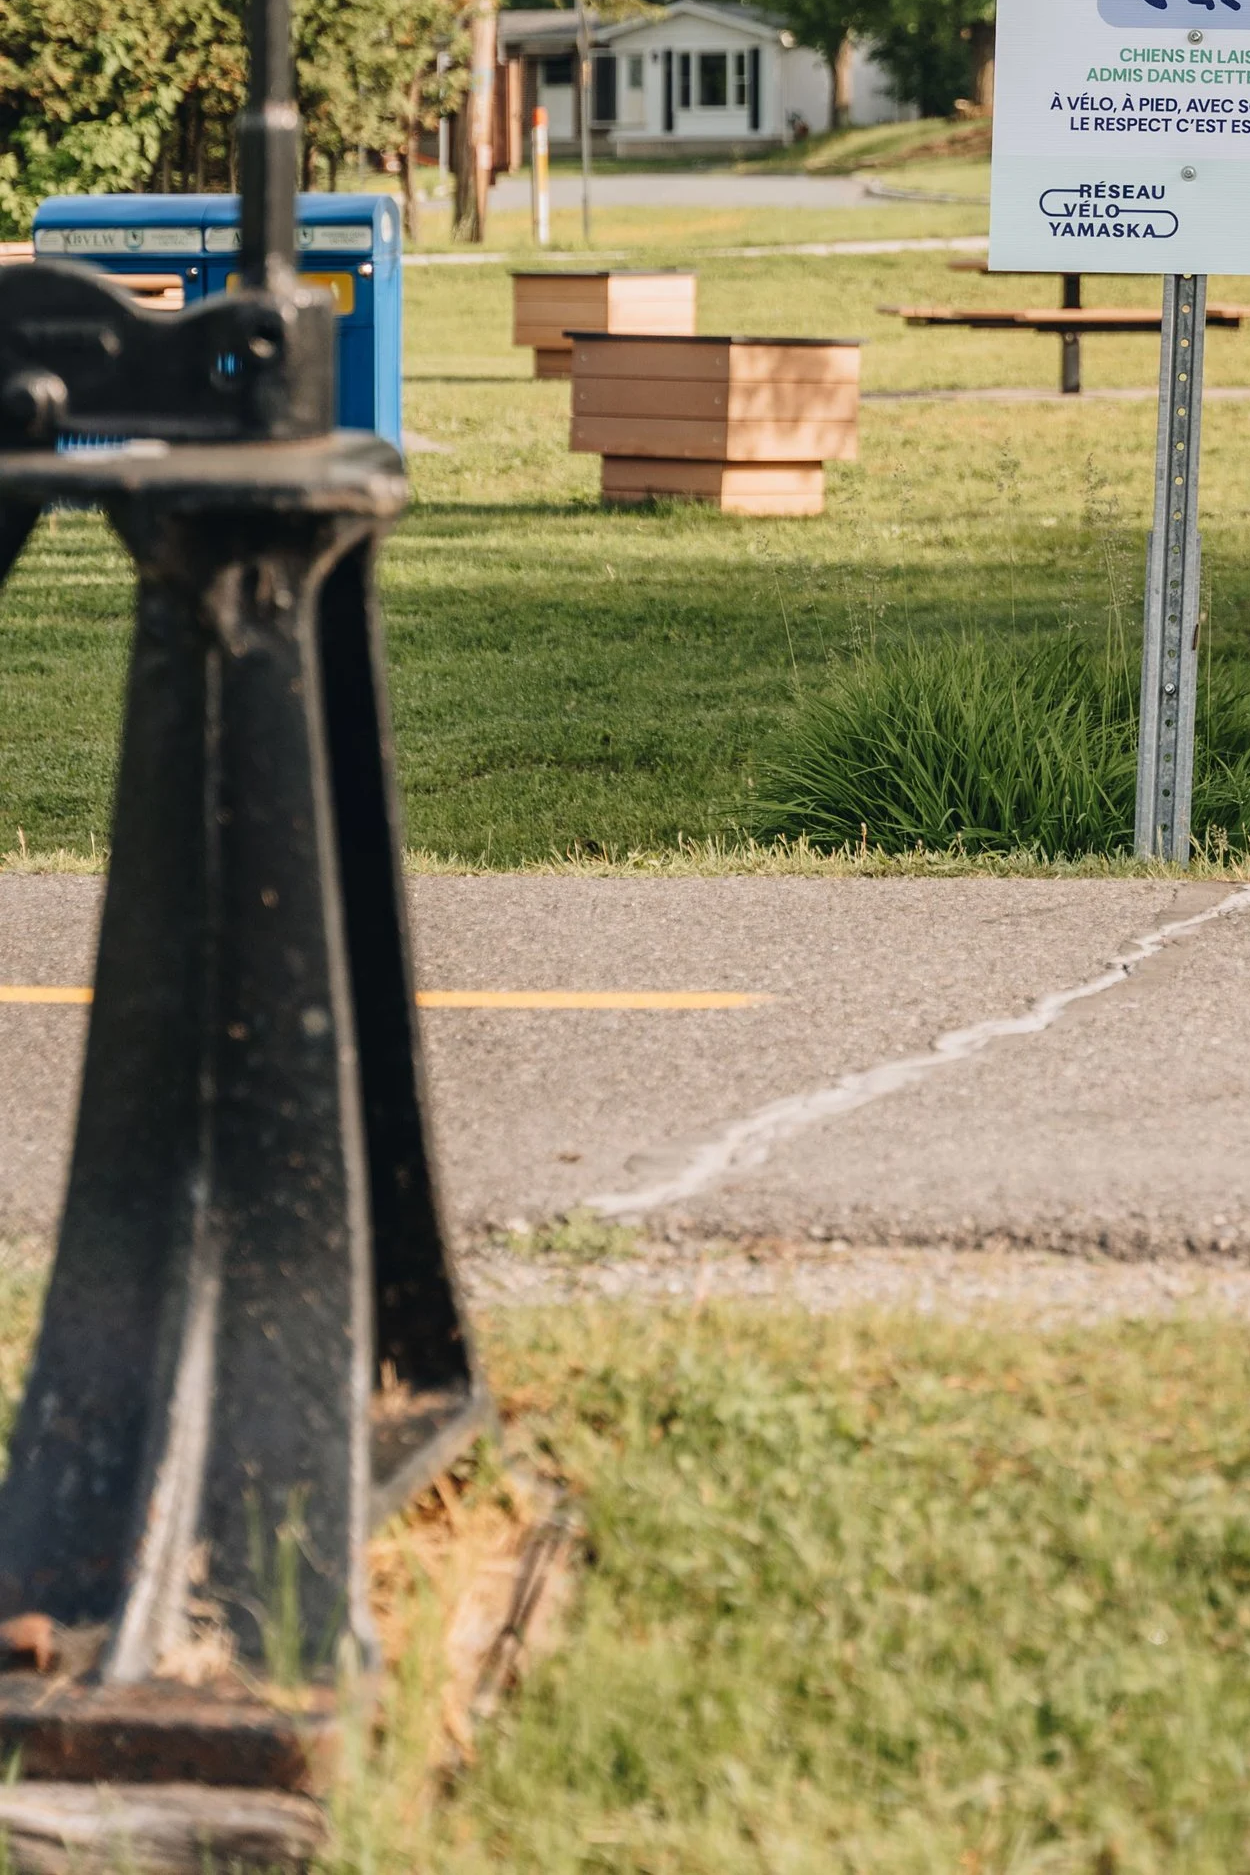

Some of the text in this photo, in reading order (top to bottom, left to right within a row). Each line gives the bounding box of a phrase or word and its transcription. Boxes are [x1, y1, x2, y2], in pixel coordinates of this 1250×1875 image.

[1119, 48, 1185, 63] CHIENS
[1190, 49, 1213, 64] EN
[1086, 67, 1144, 83] ADMIS
[1148, 68, 1196, 84] DANS
[1050, 92, 1063, 110] À
[1067, 93, 1117, 114] VÉLO,
[1122, 93, 1135, 111] À
[1139, 97, 1182, 115] PIED,
[1186, 98, 1234, 113] AVEC
[1070, 116, 1090, 131] LE
[1094, 117, 1172, 133] RESPECT
[1176, 118, 1227, 134] C’EST
[1079, 181, 1166, 200] RÉSEAU
[1063, 200, 1121, 218] VÉLO
[1049, 222, 1155, 238] YAMASKA
